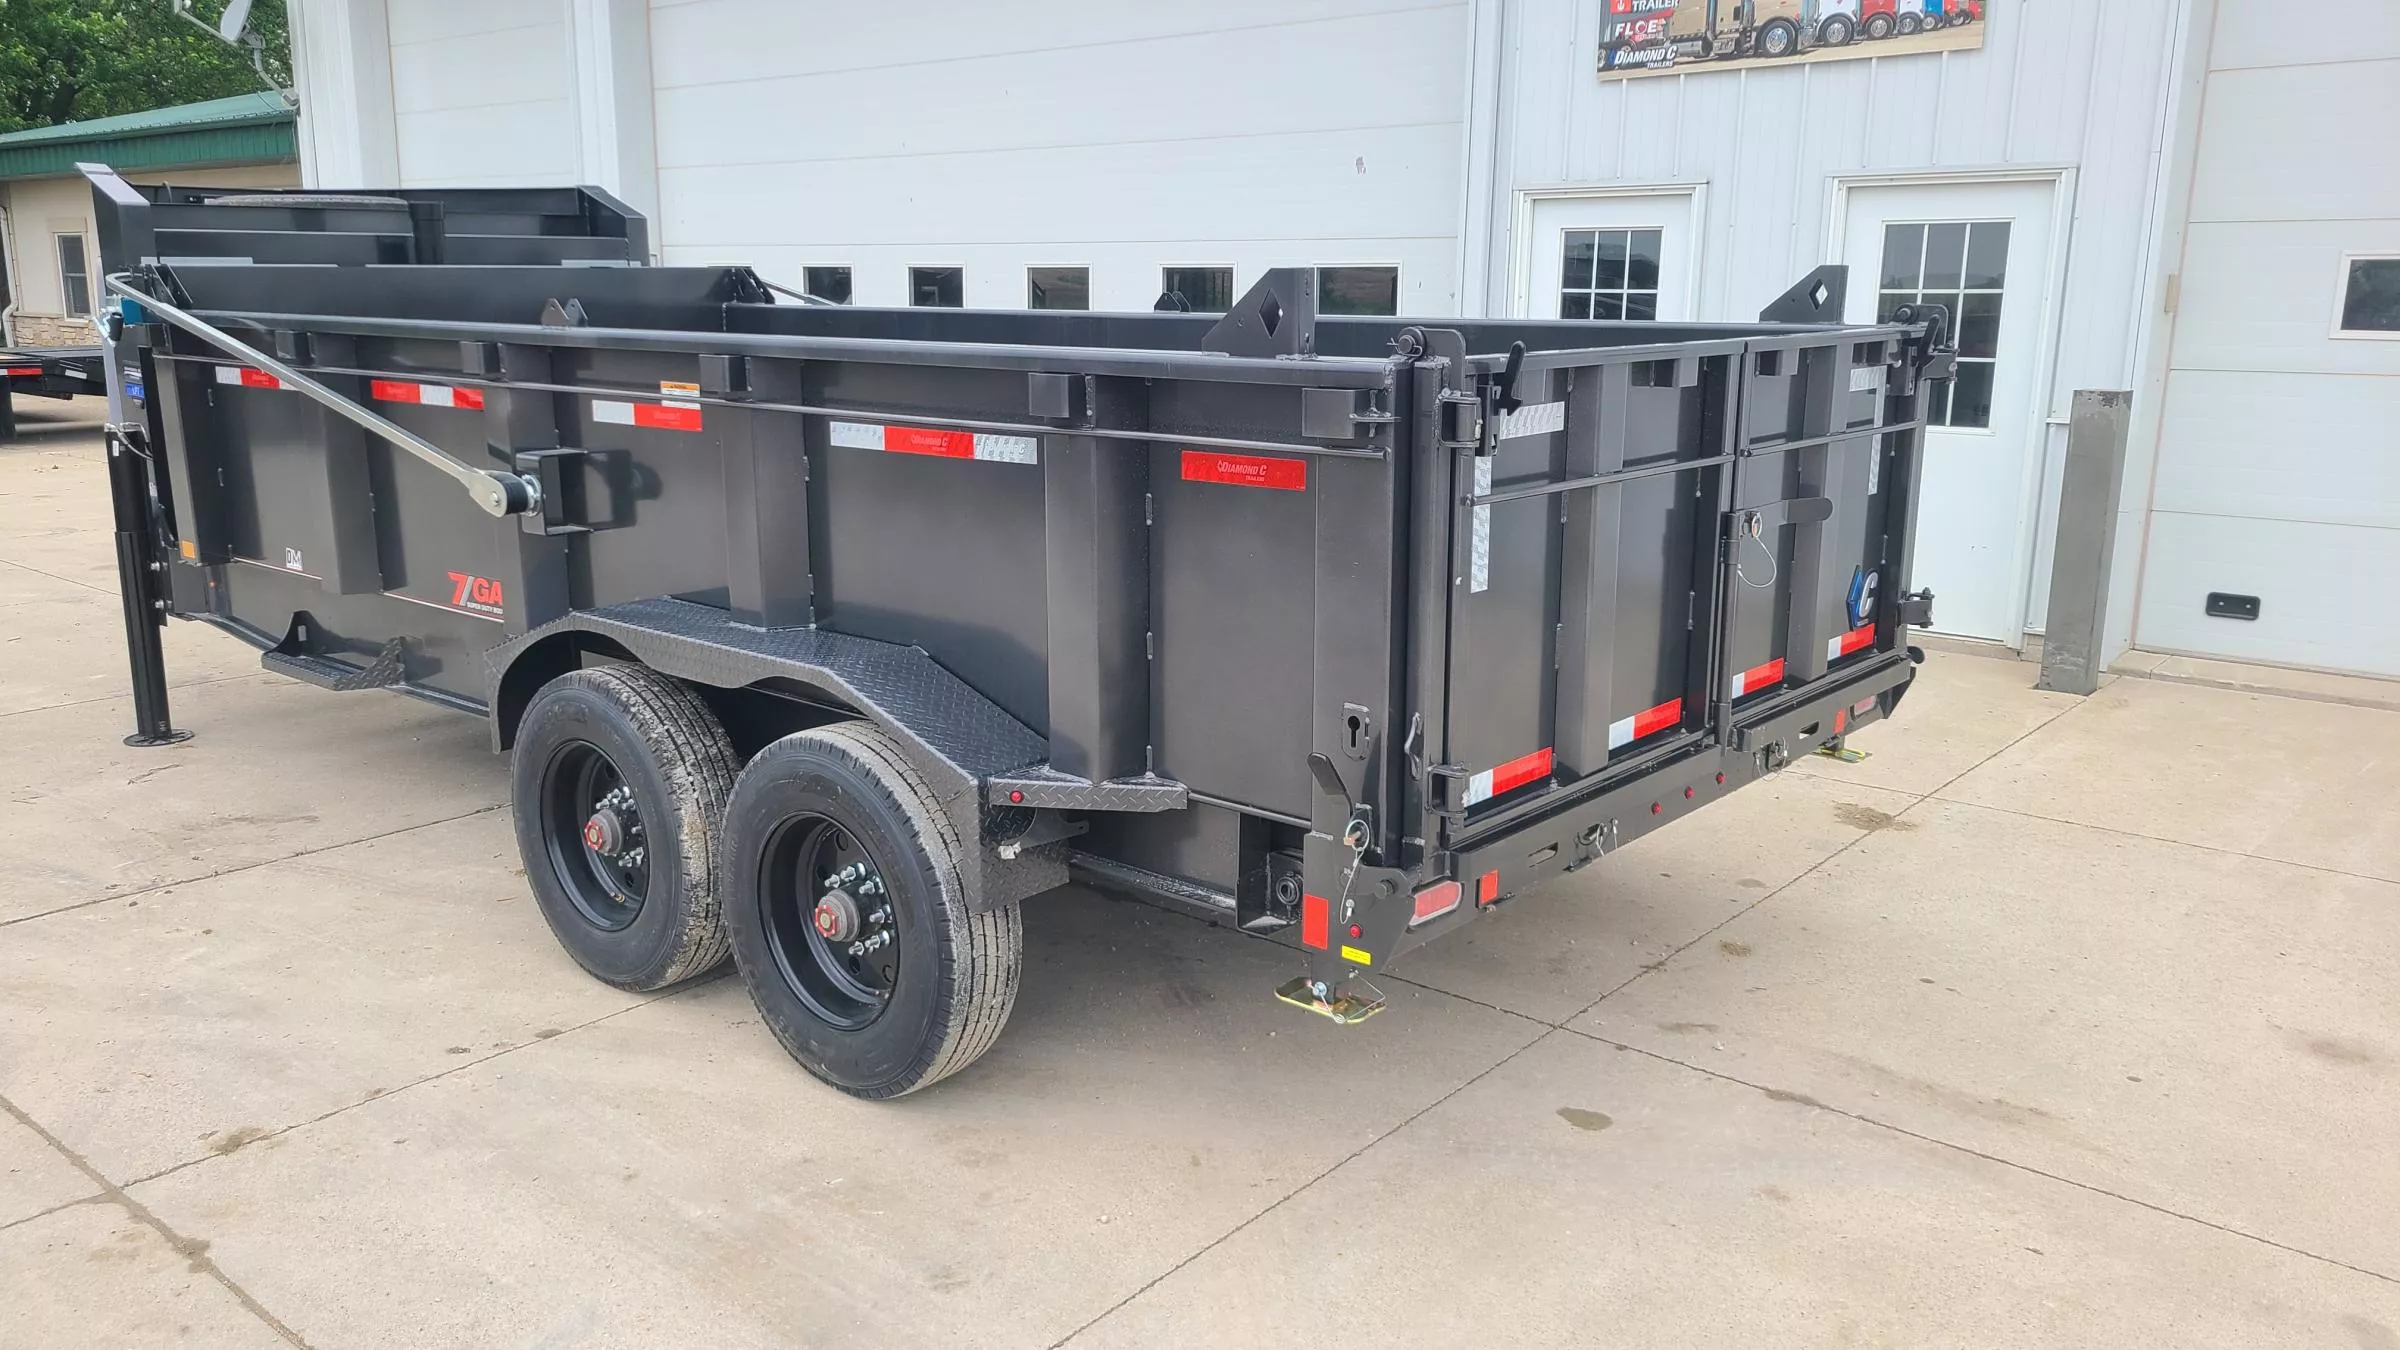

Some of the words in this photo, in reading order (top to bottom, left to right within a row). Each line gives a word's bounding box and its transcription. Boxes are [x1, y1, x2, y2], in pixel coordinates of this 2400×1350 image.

[1614, 19, 1658, 37] FLOE
[1613, 48, 1665, 65] DIAMOND
[1666, 45, 1677, 60] C
[1646, 60, 1674, 69] TRAILERS
[1221, 461, 1258, 475] DIAMOND
[1259, 464, 1267, 475] C
